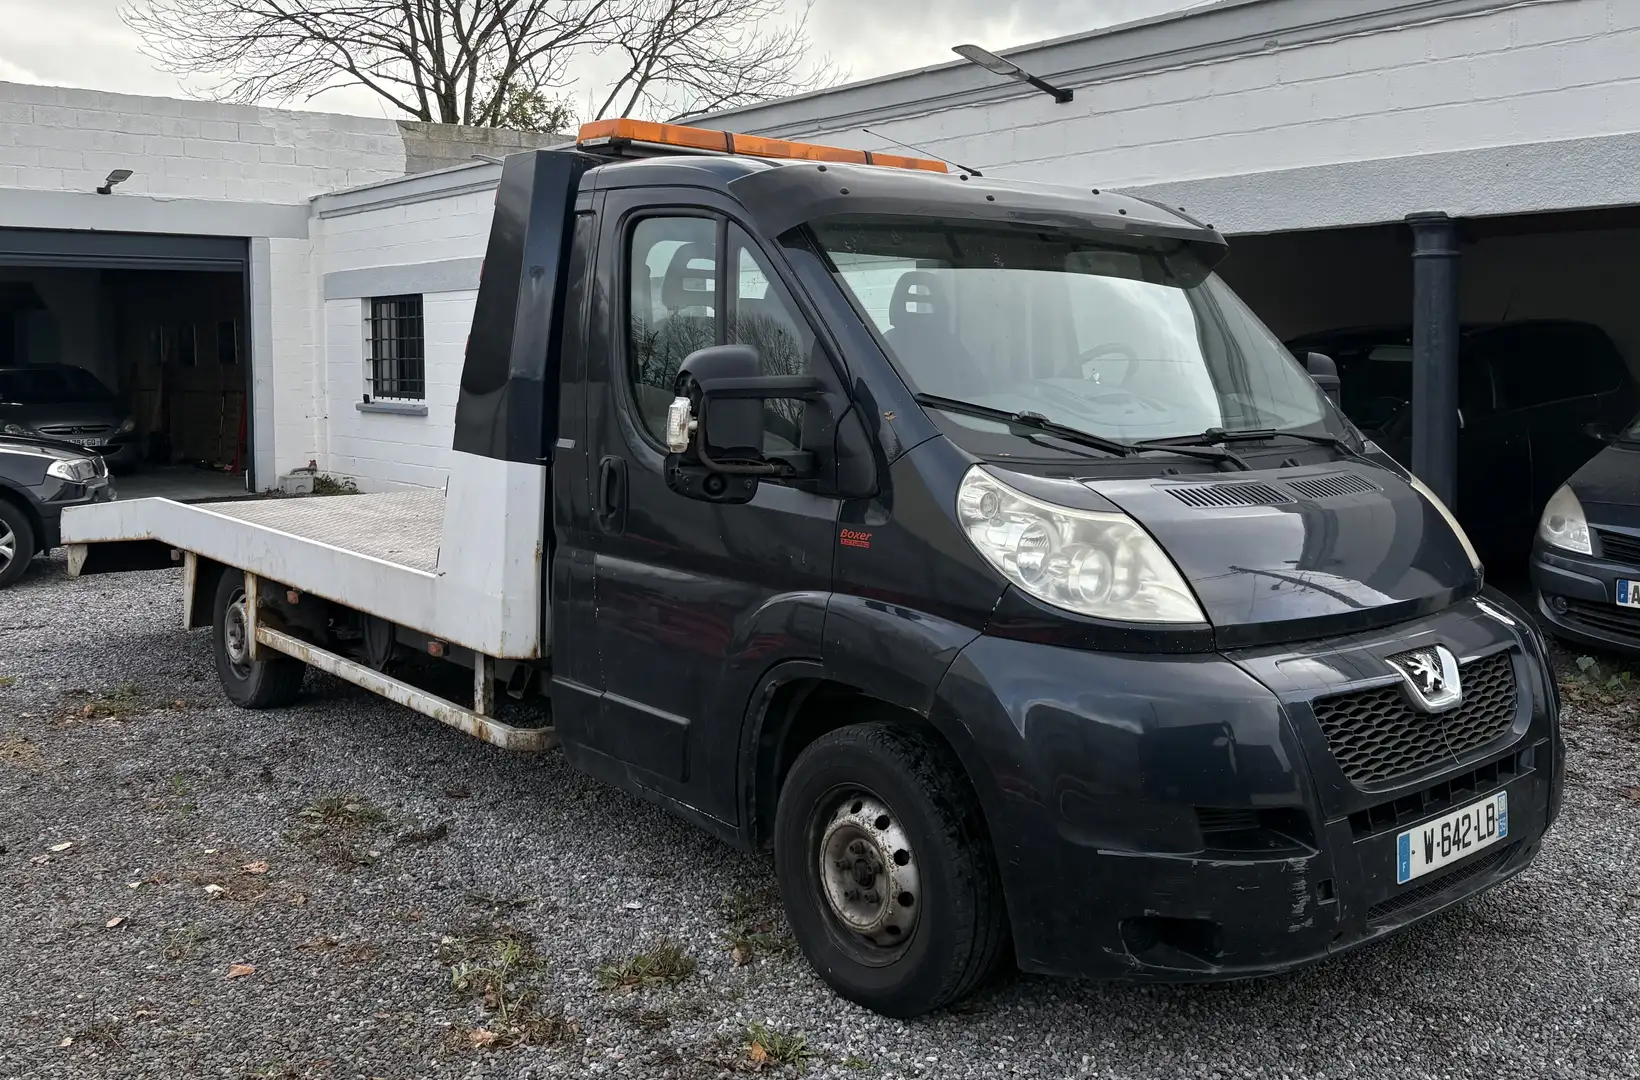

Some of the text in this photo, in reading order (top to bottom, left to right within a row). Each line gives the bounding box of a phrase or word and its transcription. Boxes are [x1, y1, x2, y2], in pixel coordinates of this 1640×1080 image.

[840, 528, 872, 541] Boxer
[1630, 585, 1640, 604] A
[1423, 802, 1495, 865] W-642-LB
[1402, 861, 1407, 873] F
